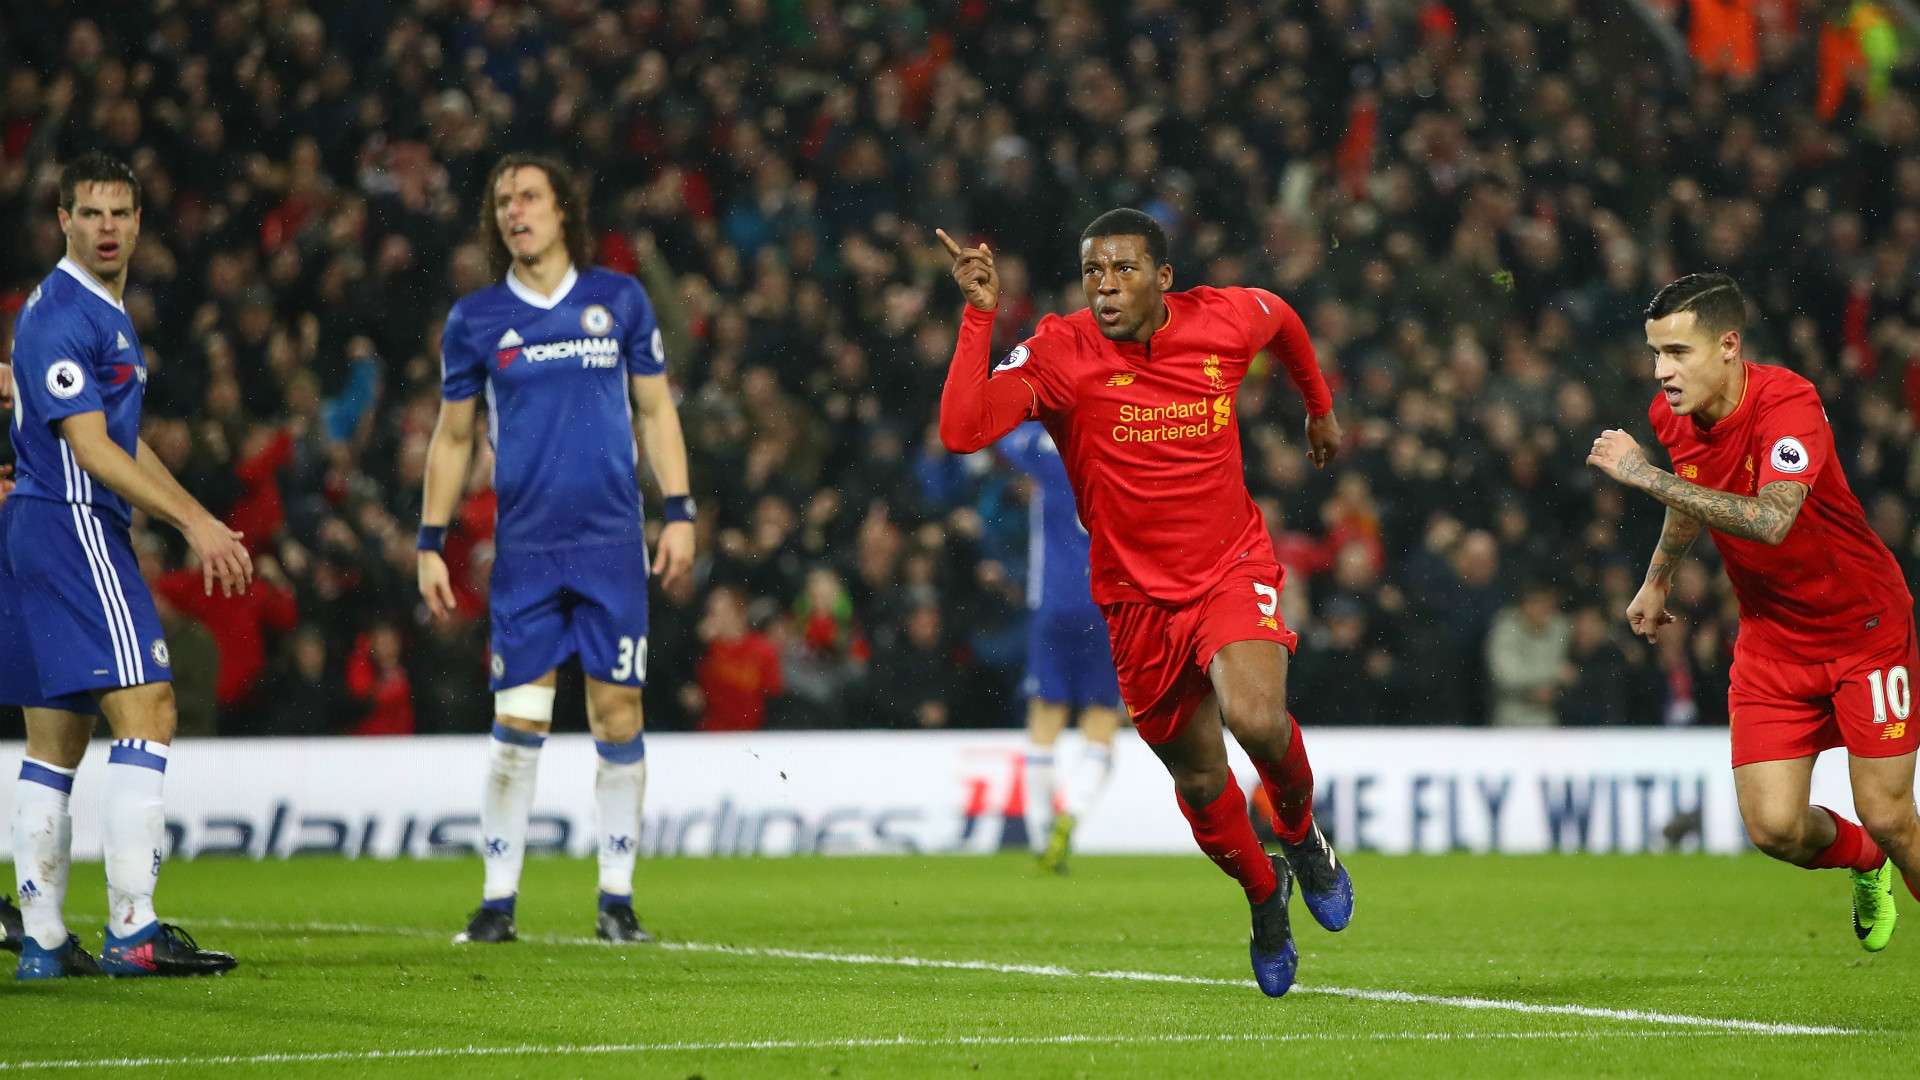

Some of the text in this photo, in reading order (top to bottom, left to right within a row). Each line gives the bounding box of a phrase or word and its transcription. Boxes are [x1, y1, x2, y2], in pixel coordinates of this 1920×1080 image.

[522, 338, 619, 363] YOKOHAMA
[1119, 397, 1208, 423] Standard
[1112, 419, 1208, 443] Chartered
[611, 635, 648, 682] 30
[1867, 665, 1911, 723] 10
[1411, 772, 1515, 853] FLY
[1540, 772, 1706, 853] WITH
